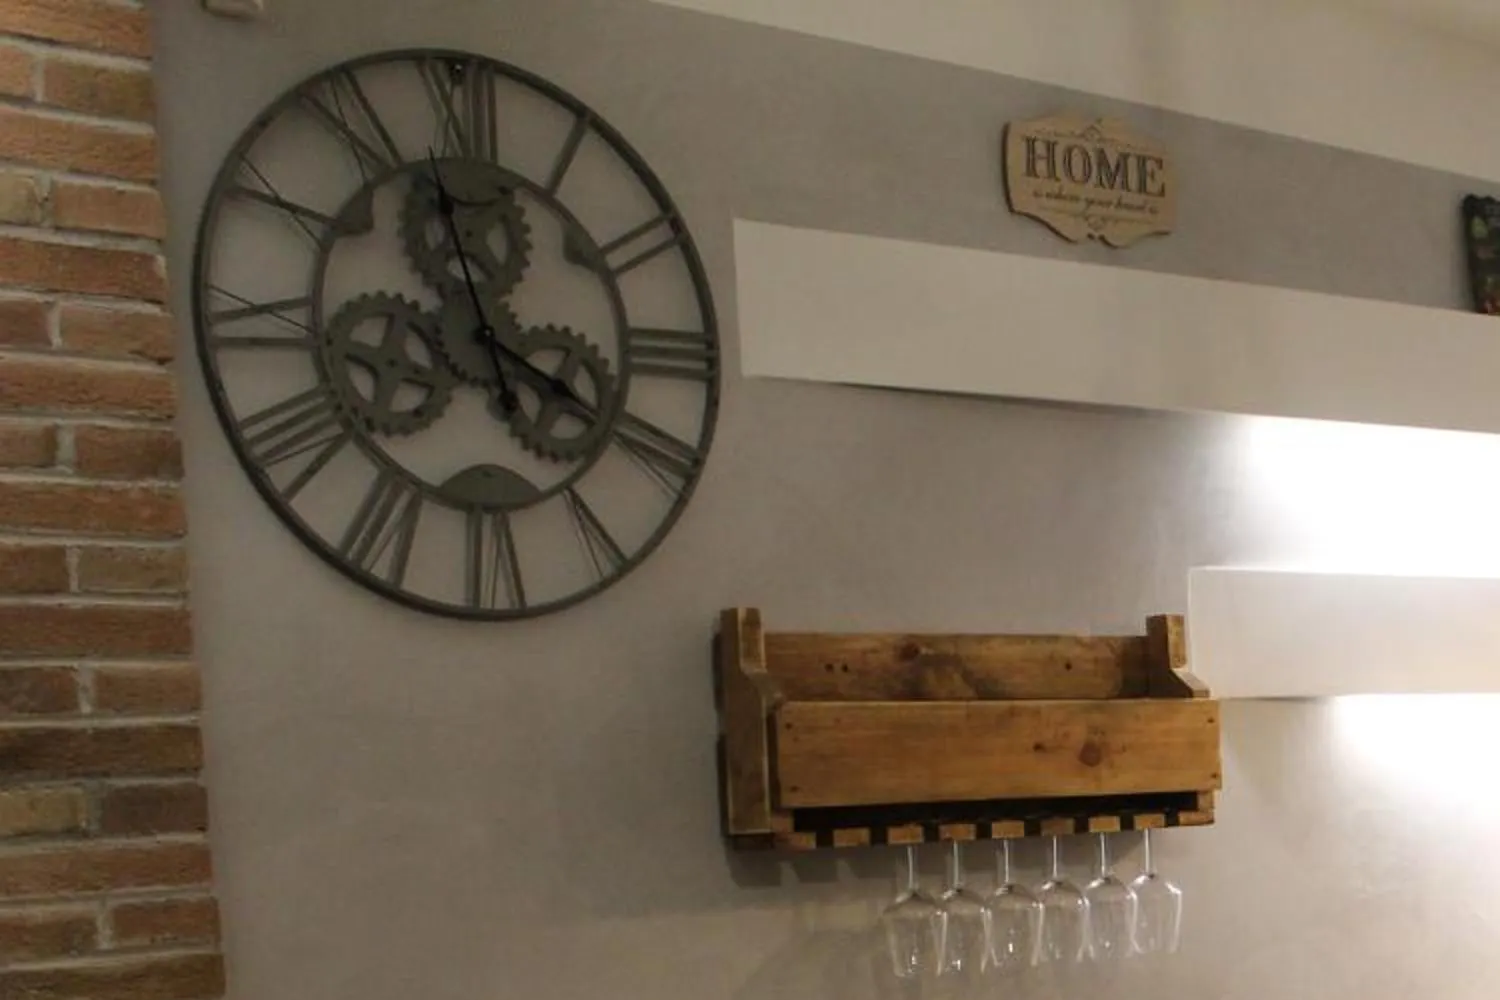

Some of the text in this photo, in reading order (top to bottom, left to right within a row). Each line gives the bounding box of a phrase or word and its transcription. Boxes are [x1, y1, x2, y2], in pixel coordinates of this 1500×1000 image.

[1022, 135, 1166, 198] HOME
[222, 153, 338, 249] X
[600, 213, 684, 275] II
[206, 283, 317, 347] IX
[628, 327, 710, 382] III
